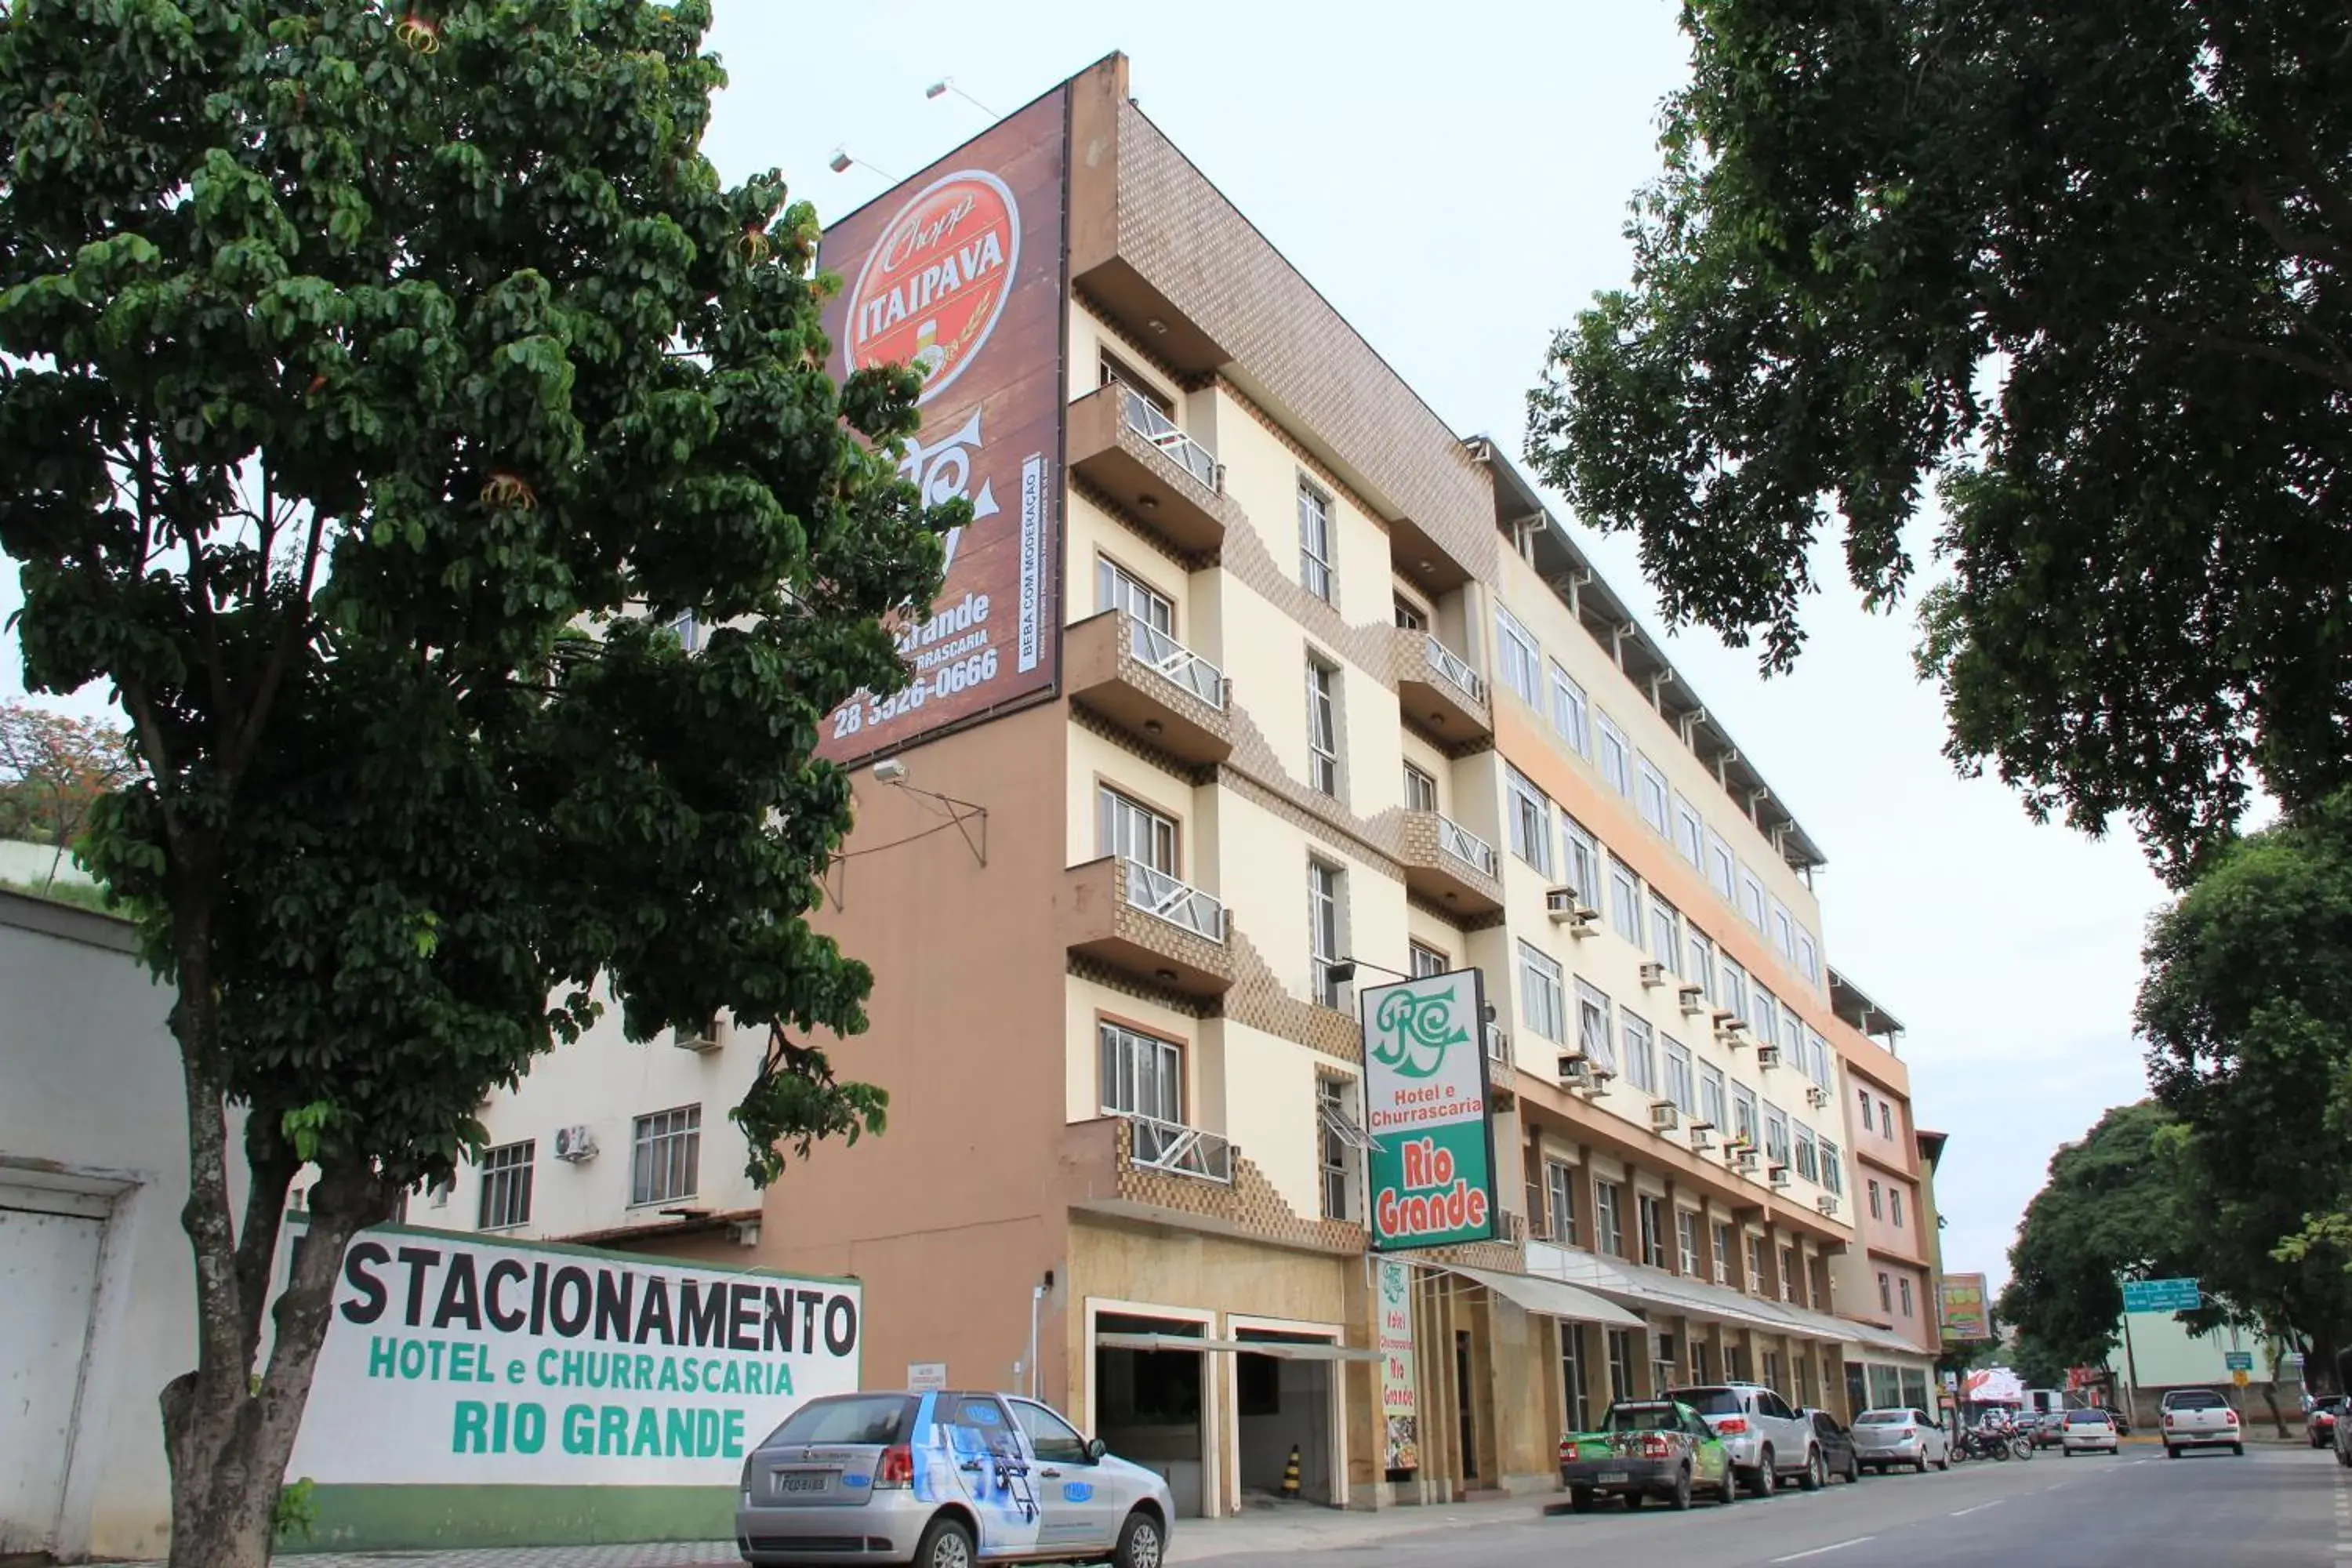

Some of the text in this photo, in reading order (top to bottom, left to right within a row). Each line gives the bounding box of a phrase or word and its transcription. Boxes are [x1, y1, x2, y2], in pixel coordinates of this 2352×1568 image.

[858, 230, 1004, 344] ITAIPAVA
[1024, 579, 1034, 609] COM
[1023, 615, 1033, 657] BEBA
[833, 702, 862, 739] 28
[1371, 1098, 1483, 1127] Churrascaria
[1395, 1084, 1455, 1106] Hotel e
[1402, 1136, 1454, 1191] Rio
[1377, 1178, 1488, 1238] Grande
[291, 1236, 857, 1356] STACIONAMENTO
[369, 1336, 794, 1396] HOTEL e CHURRASCARIA
[452, 1400, 744, 1459] RIO GRANDE
